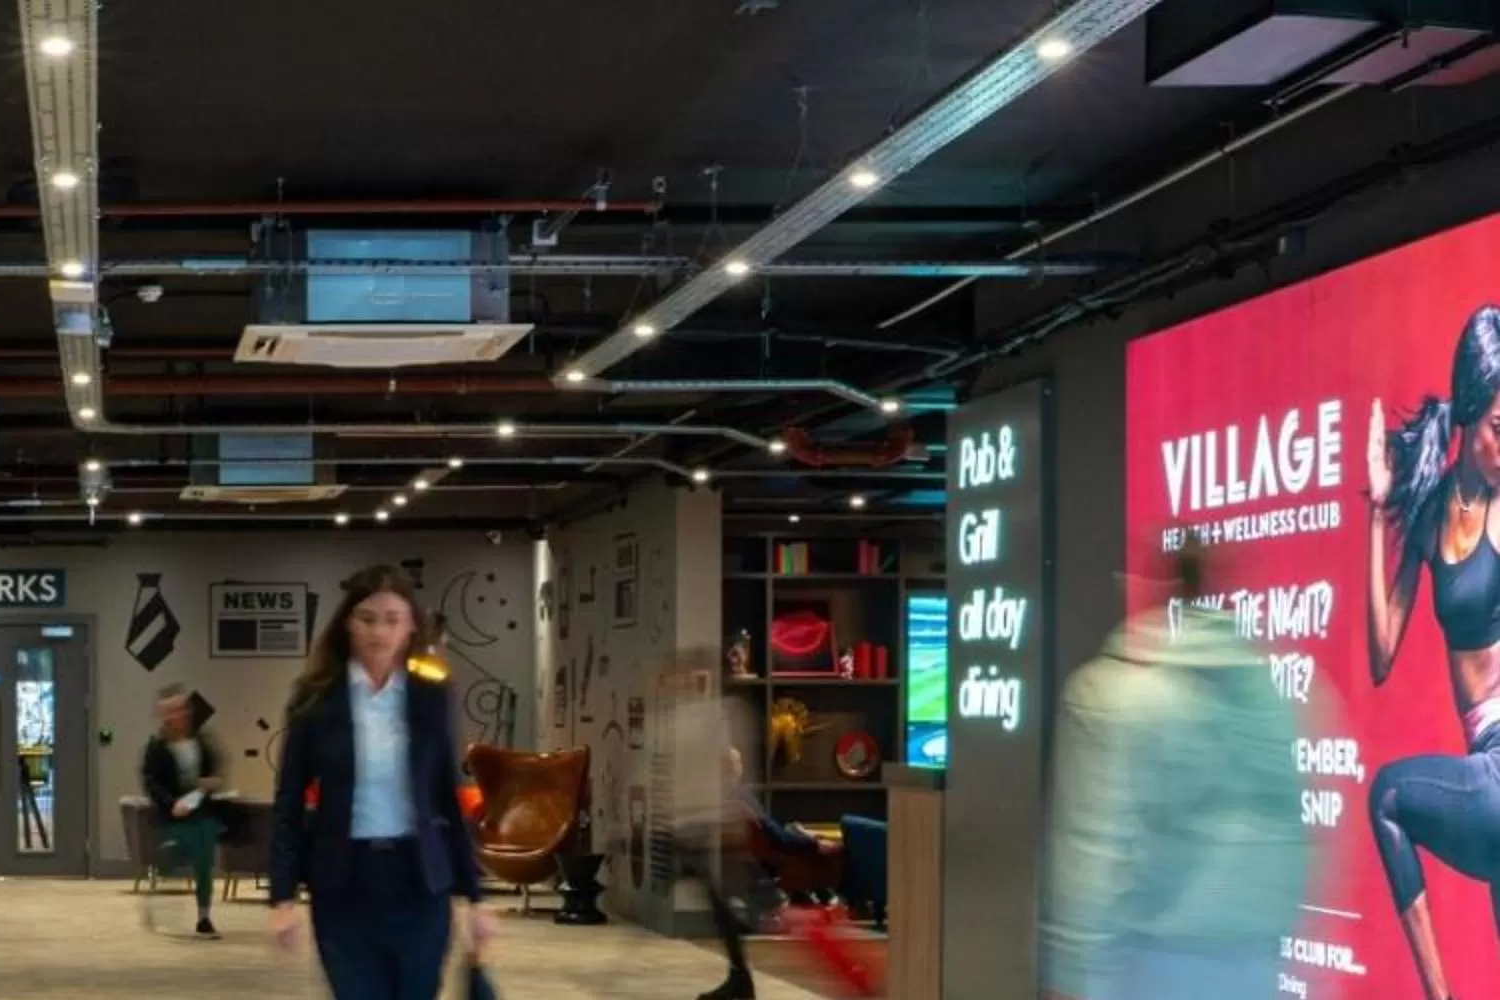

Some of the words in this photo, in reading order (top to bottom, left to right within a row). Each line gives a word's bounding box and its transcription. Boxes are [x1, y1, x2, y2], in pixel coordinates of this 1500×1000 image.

[959, 432, 996, 489] Pub
[997, 425, 1016, 480] &
[1161, 400, 1342, 518] VILLAGE
[959, 508, 1000, 565] Grill
[1162, 521, 1211, 552] HETH
[1223, 508, 1297, 542] WELLNESS
[1298, 501, 1341, 532] CLUB
[223, 591, 294, 609] NEWS
[959, 589, 985, 640] all
[986, 587, 1026, 650] day
[1229, 588, 1265, 640] THE
[1266, 579, 1333, 640] NIGHT?
[959, 665, 1021, 732] dining
[1301, 790, 1344, 828] SNIP
